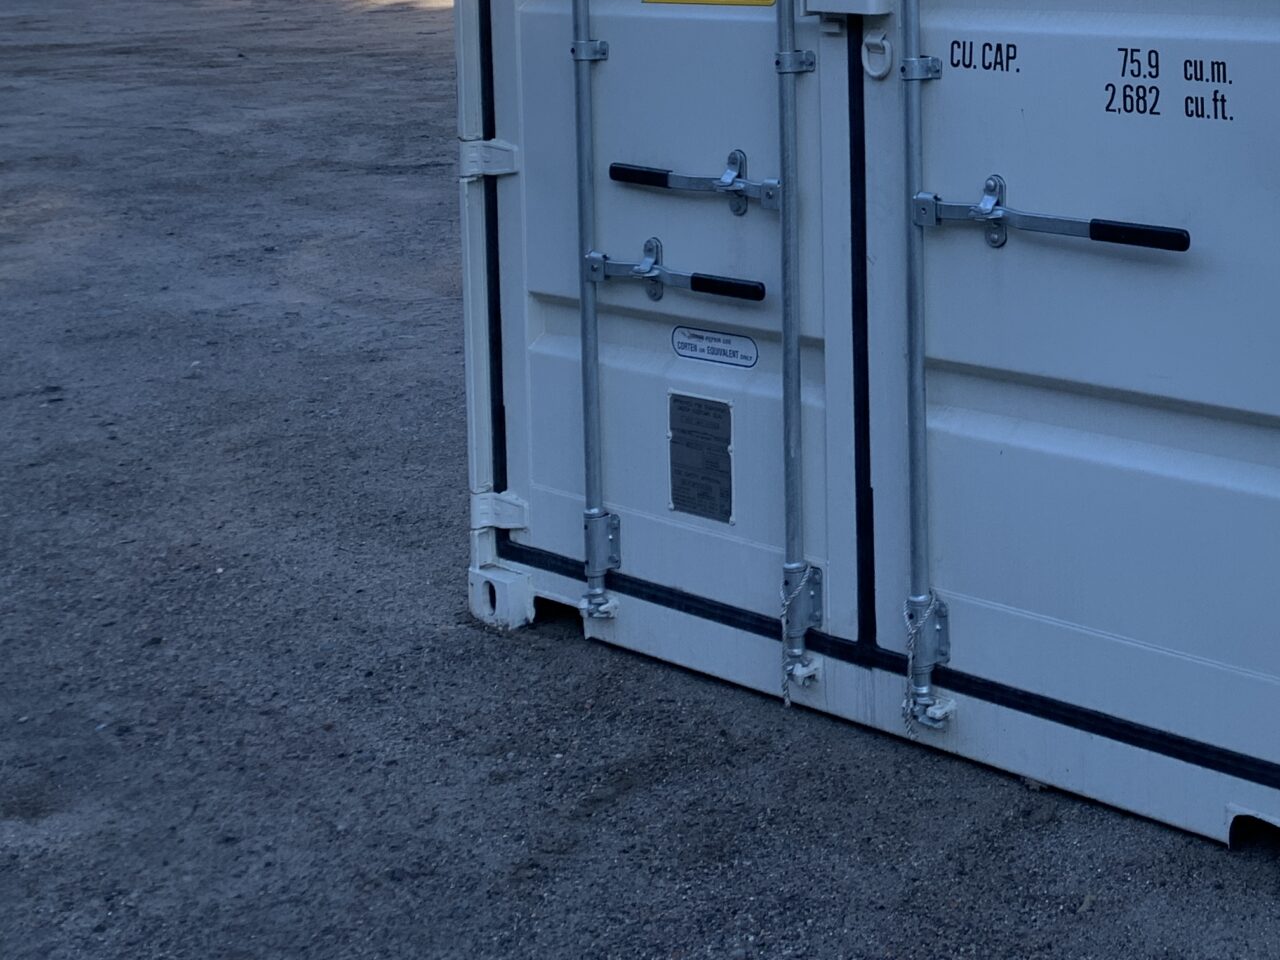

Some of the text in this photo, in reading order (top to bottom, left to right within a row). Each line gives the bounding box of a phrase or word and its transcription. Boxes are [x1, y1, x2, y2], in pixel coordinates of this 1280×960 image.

[1117, 48, 1159, 79] 75.9
[1184, 59, 1233, 84] cu.m.
[1105, 83, 1234, 121] 2,682 cu.ft.
[707, 346, 739, 359] EQUIVALENT
